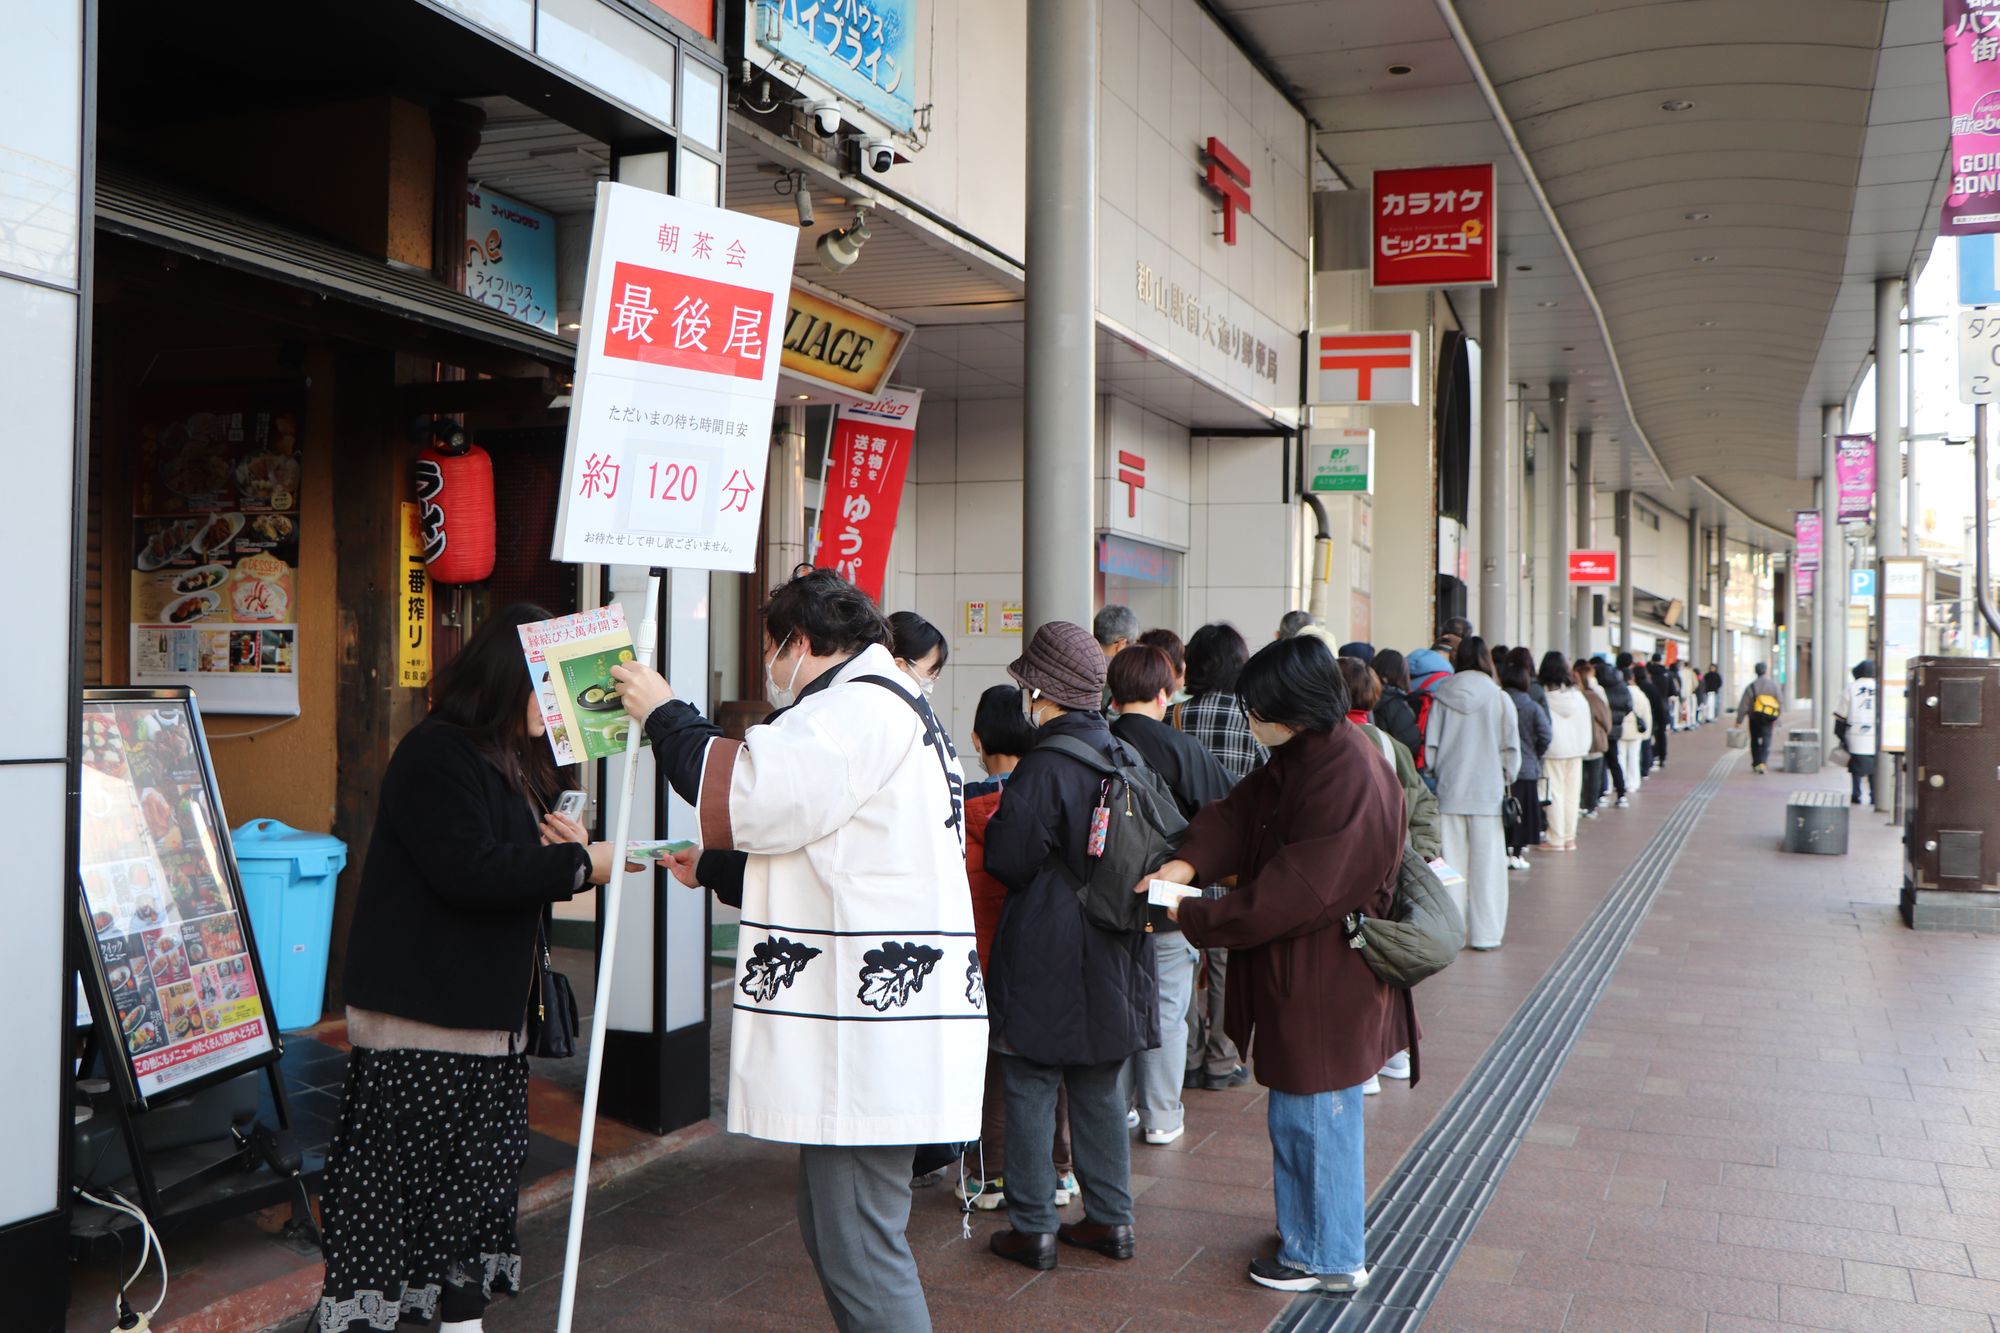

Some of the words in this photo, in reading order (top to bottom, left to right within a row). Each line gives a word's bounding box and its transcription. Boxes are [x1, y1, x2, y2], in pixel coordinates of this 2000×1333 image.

[1952, 174, 2000, 195] BON
[1382, 189, 1483, 216] カラオケ
[656, 223, 747, 268] 朝茶会
[1381, 232, 1482, 256] ビッグエコー
[476, 271, 533, 300] ライフハウス
[611, 282, 763, 360] 最後尾
[1136, 260, 1278, 385] 郡山駅前大通り郵便局
[608, 404, 749, 438] ただいまの待ち時間目安
[848, 434, 870, 488] 送るなら
[867, 437, 888, 481] 荷物を
[579, 452, 621, 500] 約
[649, 461, 698, 502] 120
[720, 468, 756, 513] 分
[584, 531, 734, 555] お待たせして申し訳ございません。
[1853, 573, 1870, 593] P
[408, 554, 426, 649] 一番搾り
[100, 940, 123, 954] クイック
[104, 952, 127, 963] メニュー
